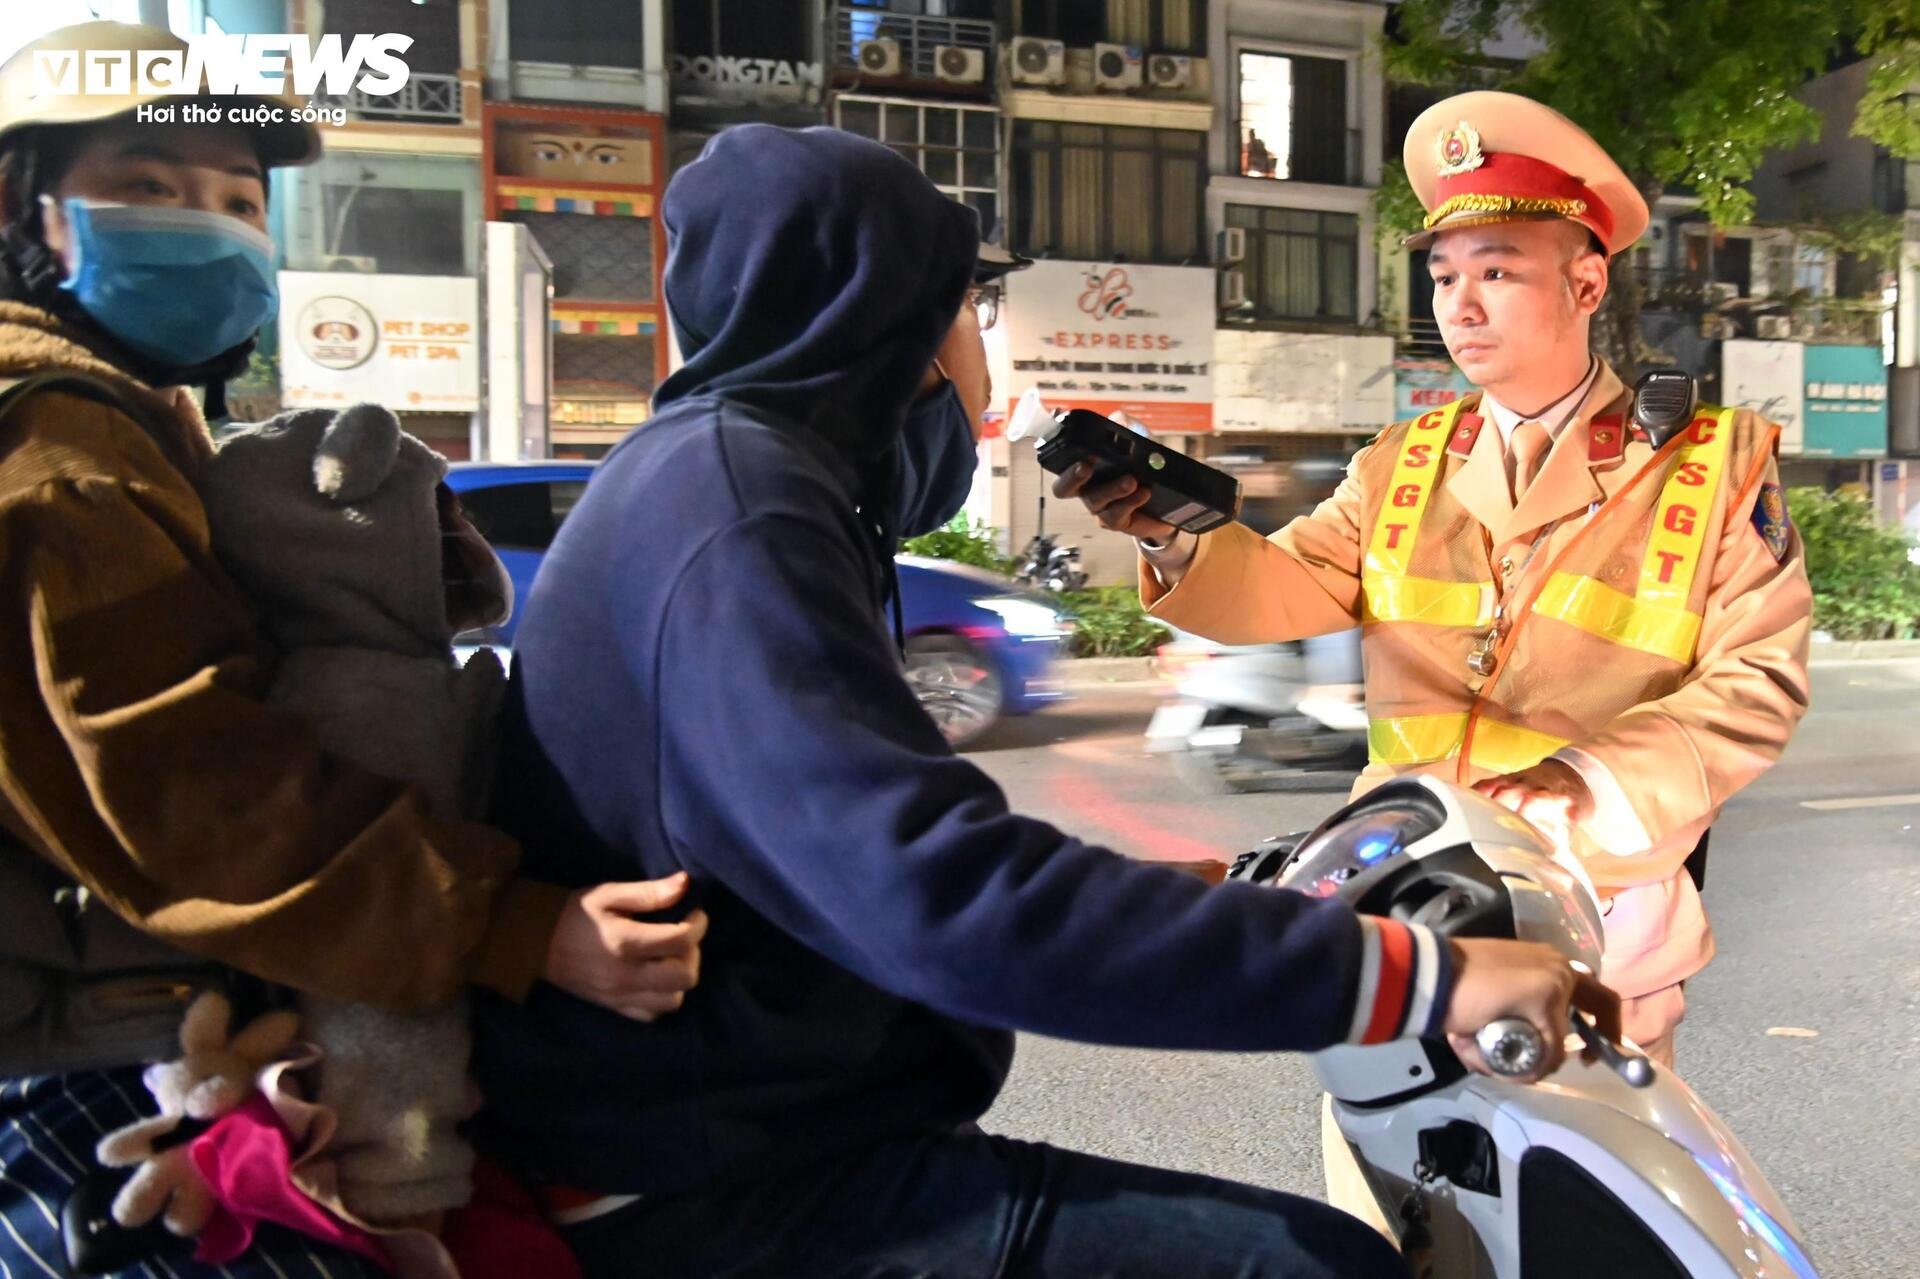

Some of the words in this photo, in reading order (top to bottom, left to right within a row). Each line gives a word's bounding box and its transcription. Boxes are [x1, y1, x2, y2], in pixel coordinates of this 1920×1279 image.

[383, 320, 414, 336] PET
[420, 322, 470, 337] SHOP
[1054, 331, 1172, 351] EXPRESS
[388, 345, 419, 358] PET
[426, 346, 461, 361] SPA
